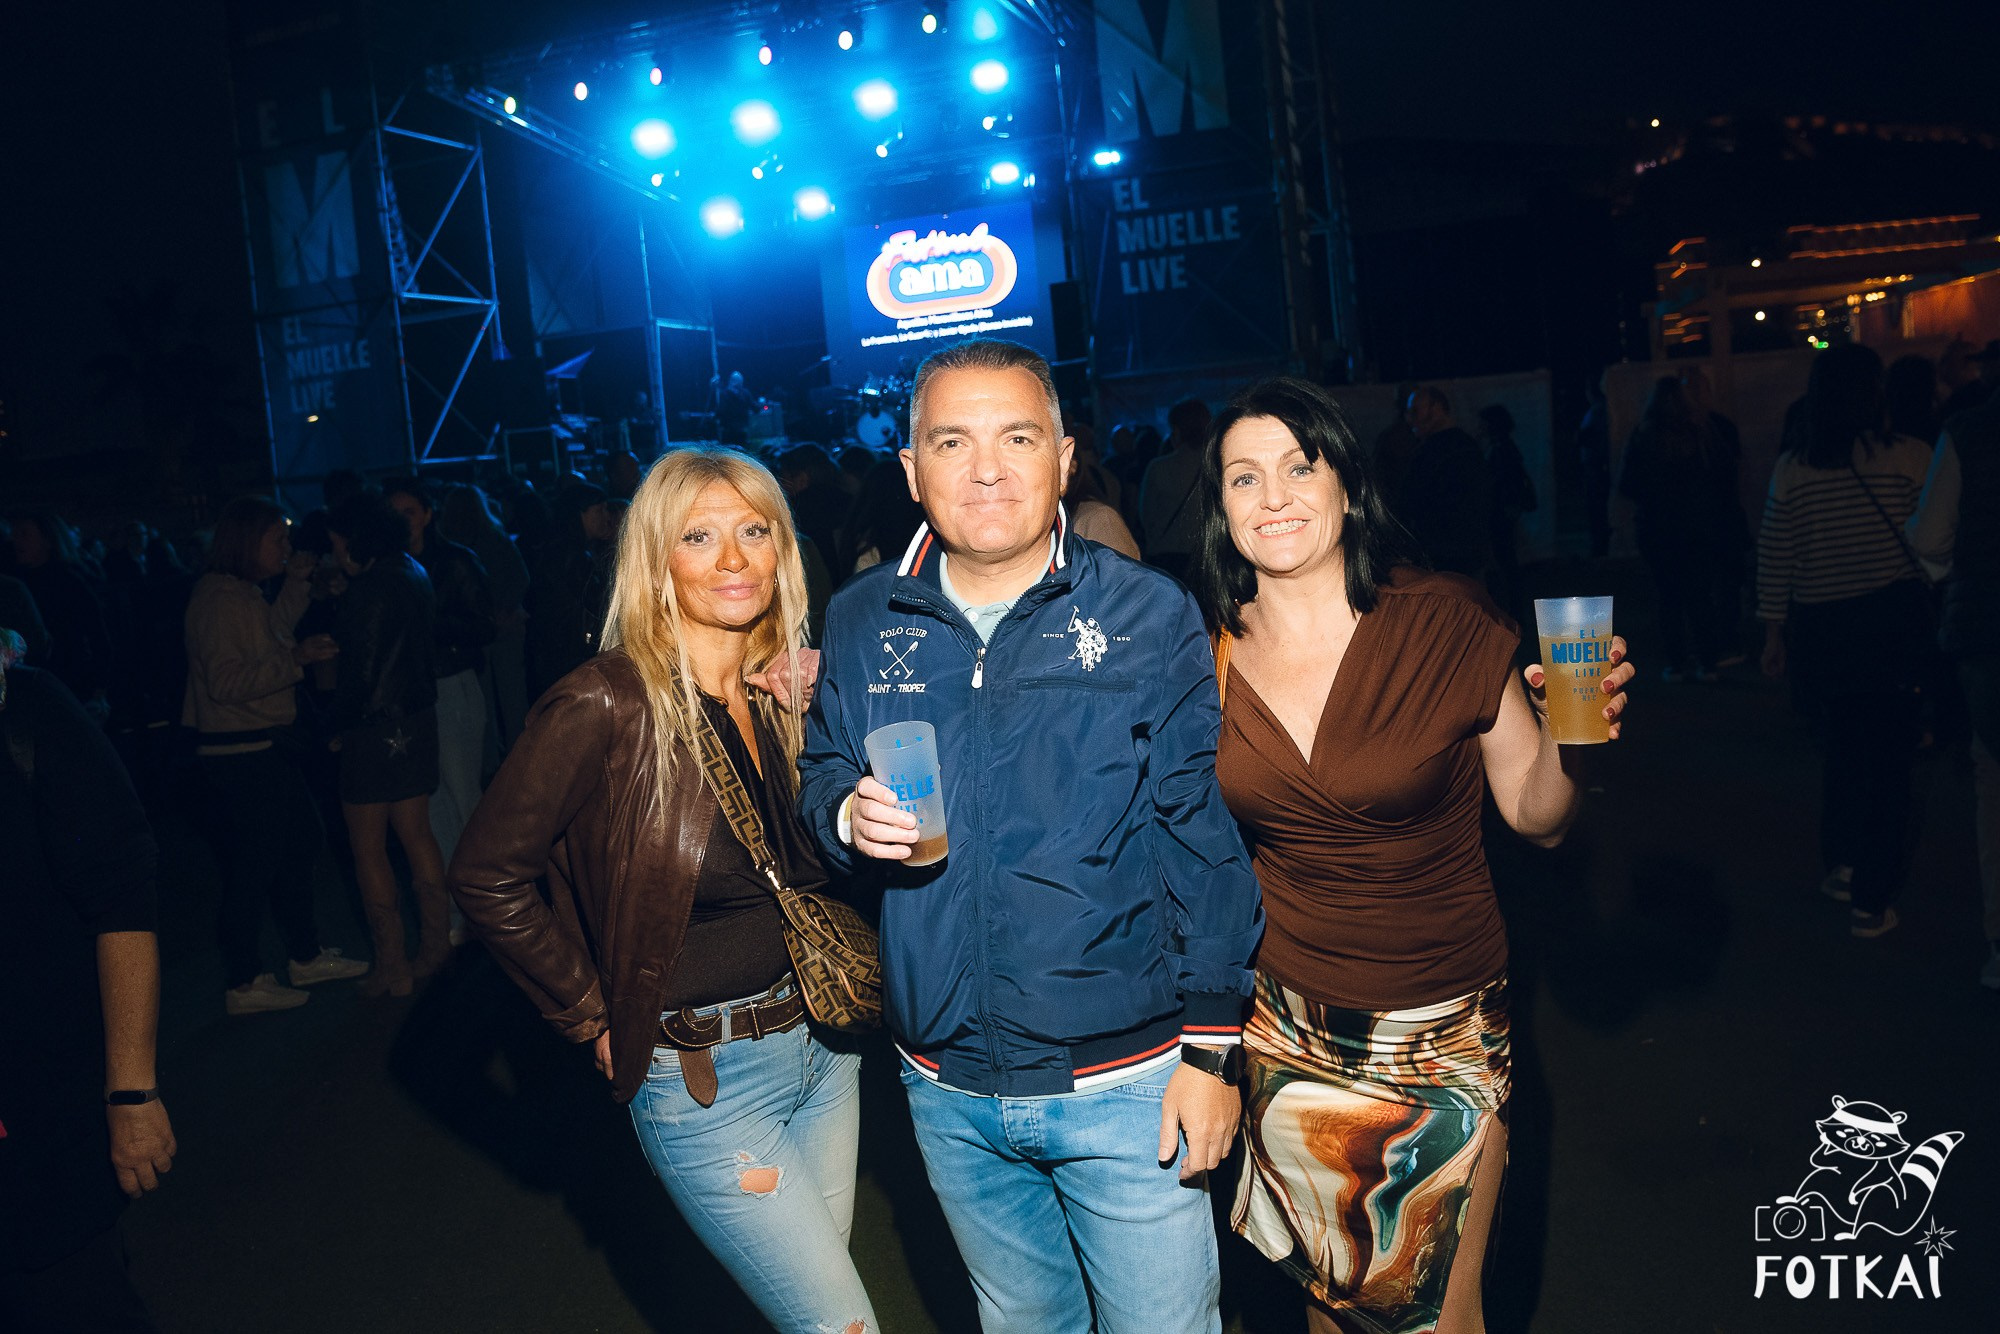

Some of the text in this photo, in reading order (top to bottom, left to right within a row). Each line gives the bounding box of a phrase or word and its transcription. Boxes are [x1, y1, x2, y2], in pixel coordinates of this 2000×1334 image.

[1112, 177, 1149, 212] EL
[1115, 204, 1240, 254] MUELLE
[1121, 254, 1188, 295] LIVE
[281, 316, 308, 345] EL
[285, 339, 371, 380] MUELLE
[289, 380, 336, 413] LIVE
[879, 626, 928, 640] POLO CLUB
[1579, 628, 1597, 639] EL
[1551, 641, 1613, 664] MUELL
[867, 683, 892, 694] SAINT
[897, 683, 926, 693] TROPEZ
